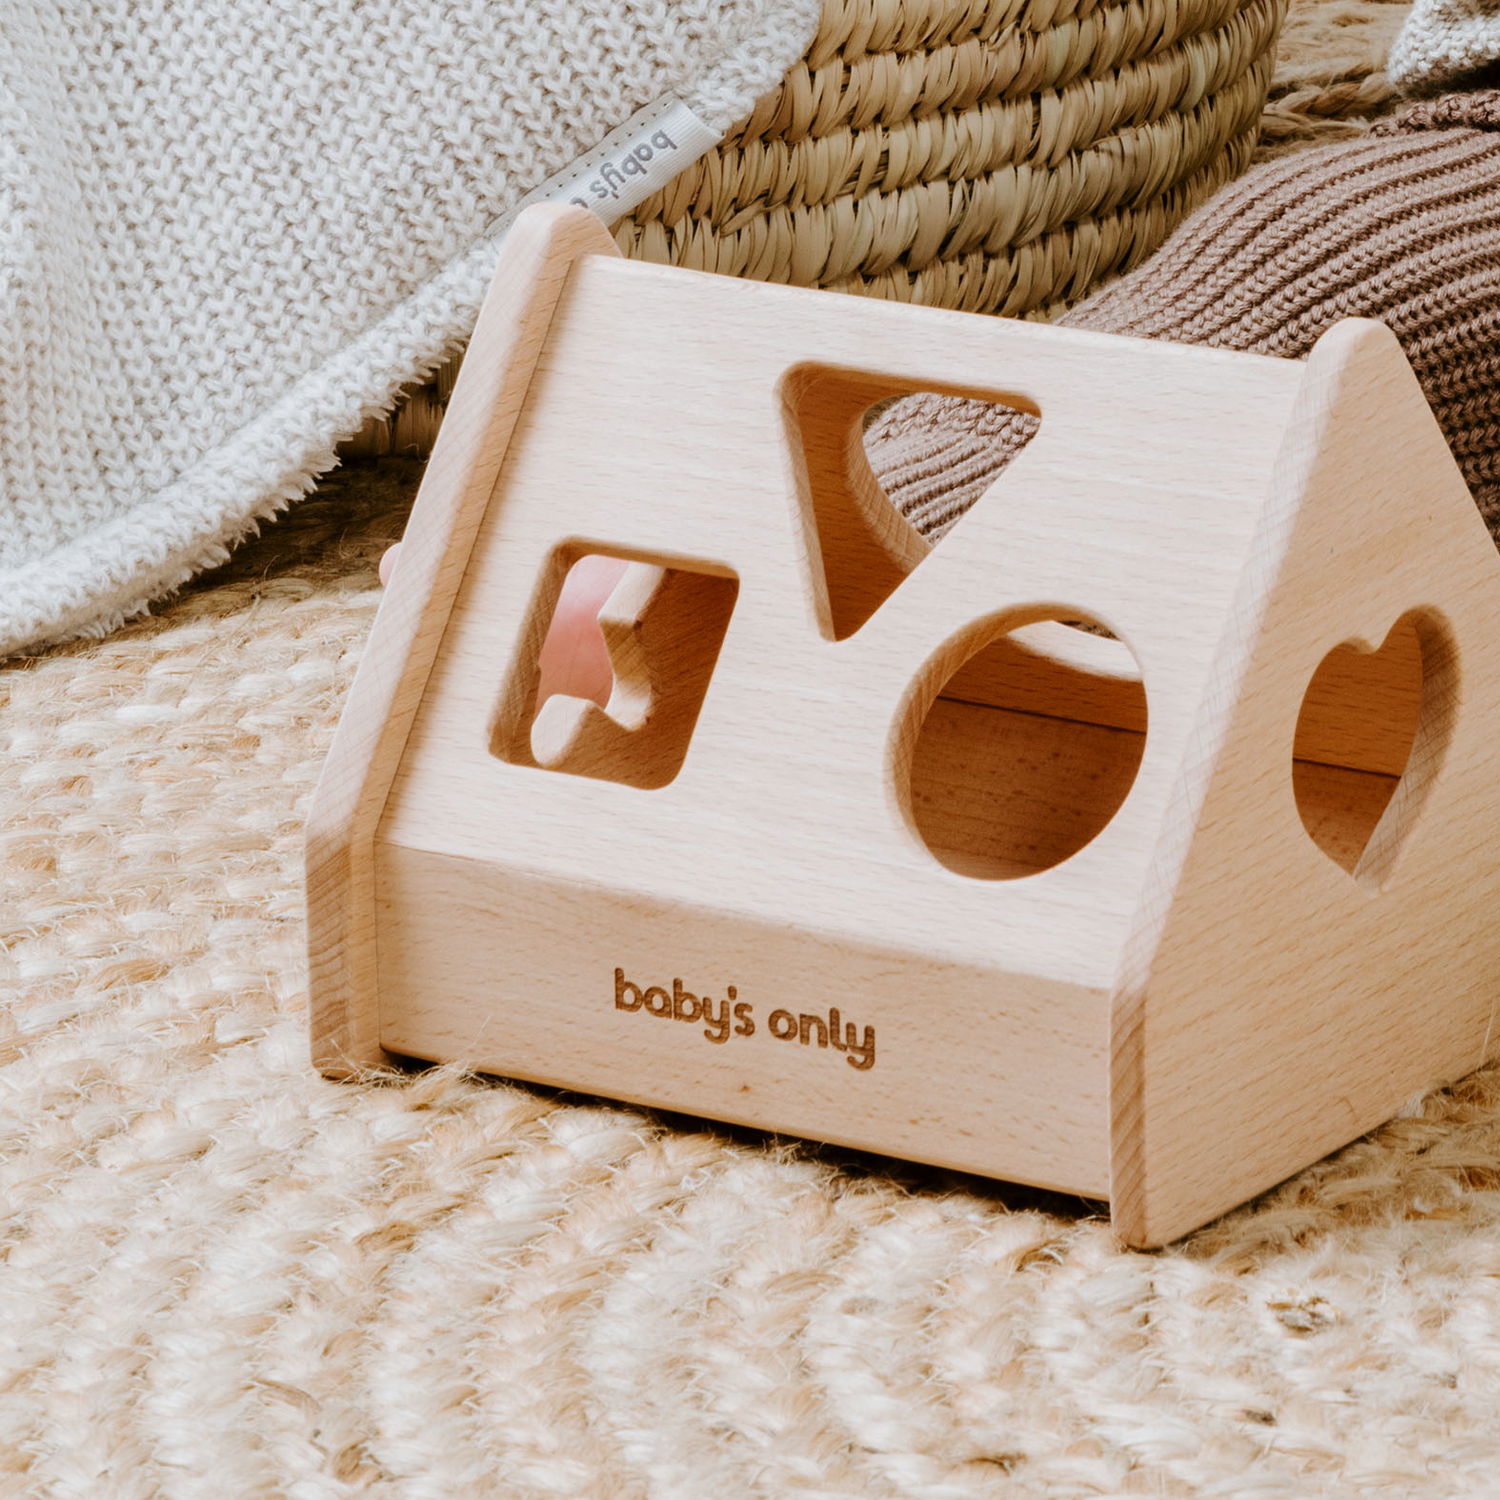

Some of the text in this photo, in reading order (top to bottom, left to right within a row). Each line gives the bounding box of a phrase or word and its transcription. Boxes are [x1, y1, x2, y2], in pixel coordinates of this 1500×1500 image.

[589, 129, 678, 199] baby's
[614, 967, 875, 1071] baby's only
